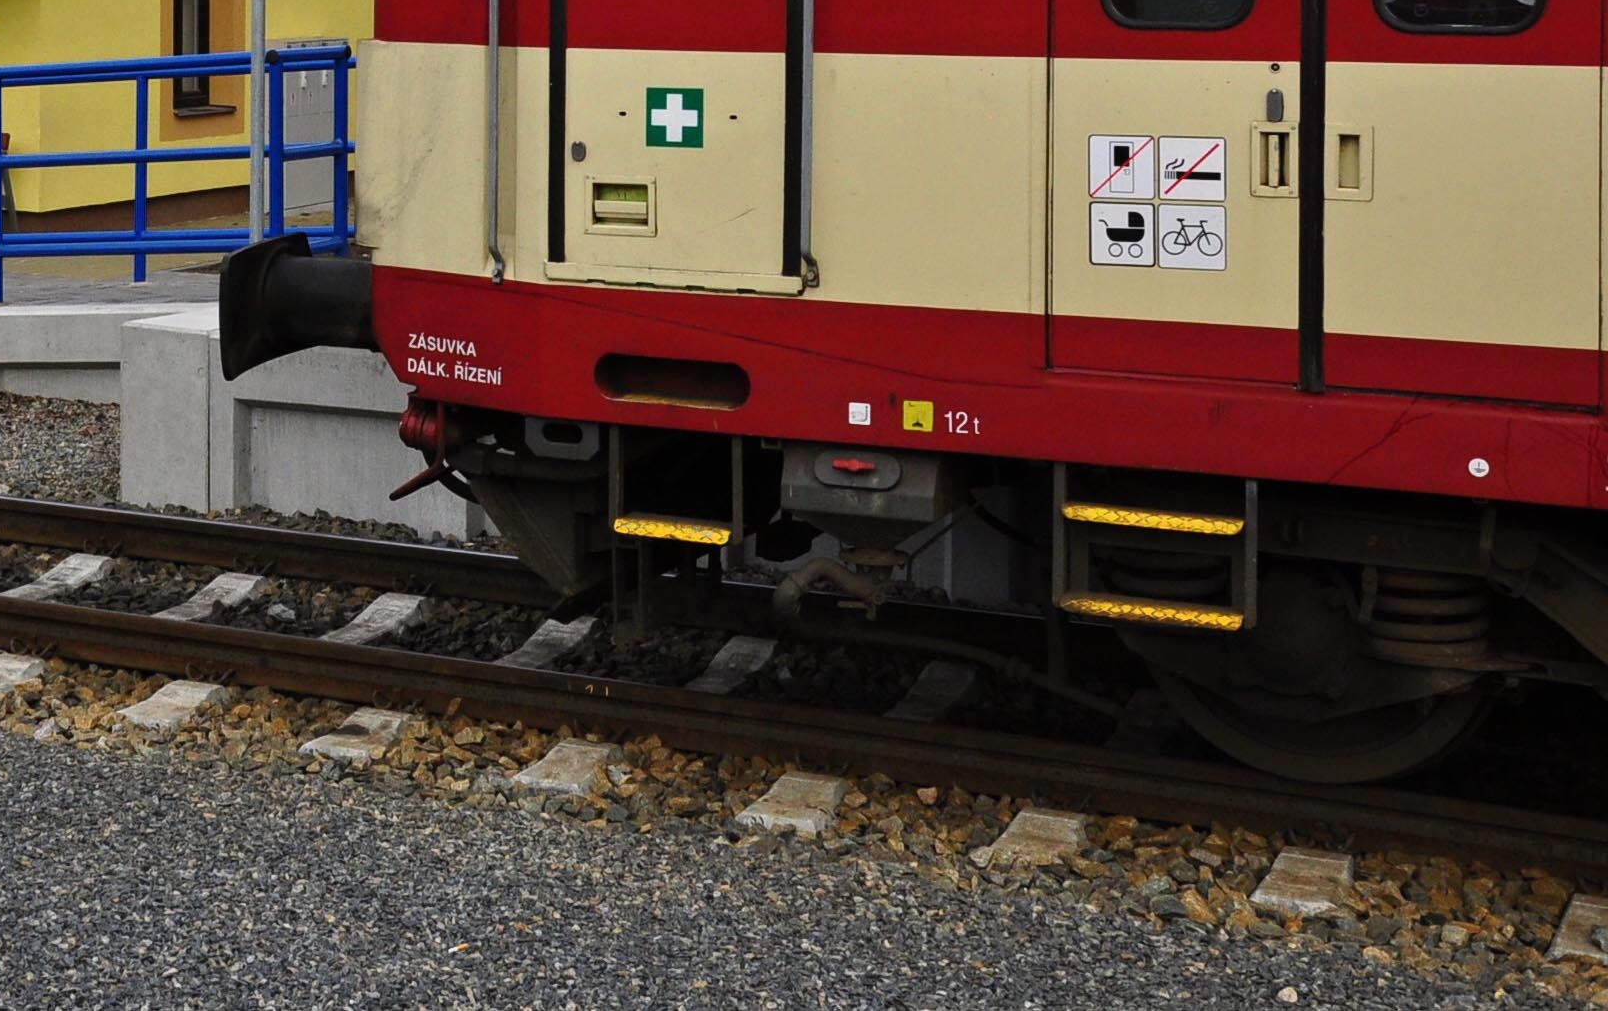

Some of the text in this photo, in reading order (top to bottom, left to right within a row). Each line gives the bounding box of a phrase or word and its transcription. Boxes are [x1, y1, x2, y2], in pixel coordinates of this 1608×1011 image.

[408, 332, 477, 357] ZÁSUVKA
[407, 357, 503, 386] DÁLK. ŘÍZENÍ
[944, 410, 981, 435] 12 t
